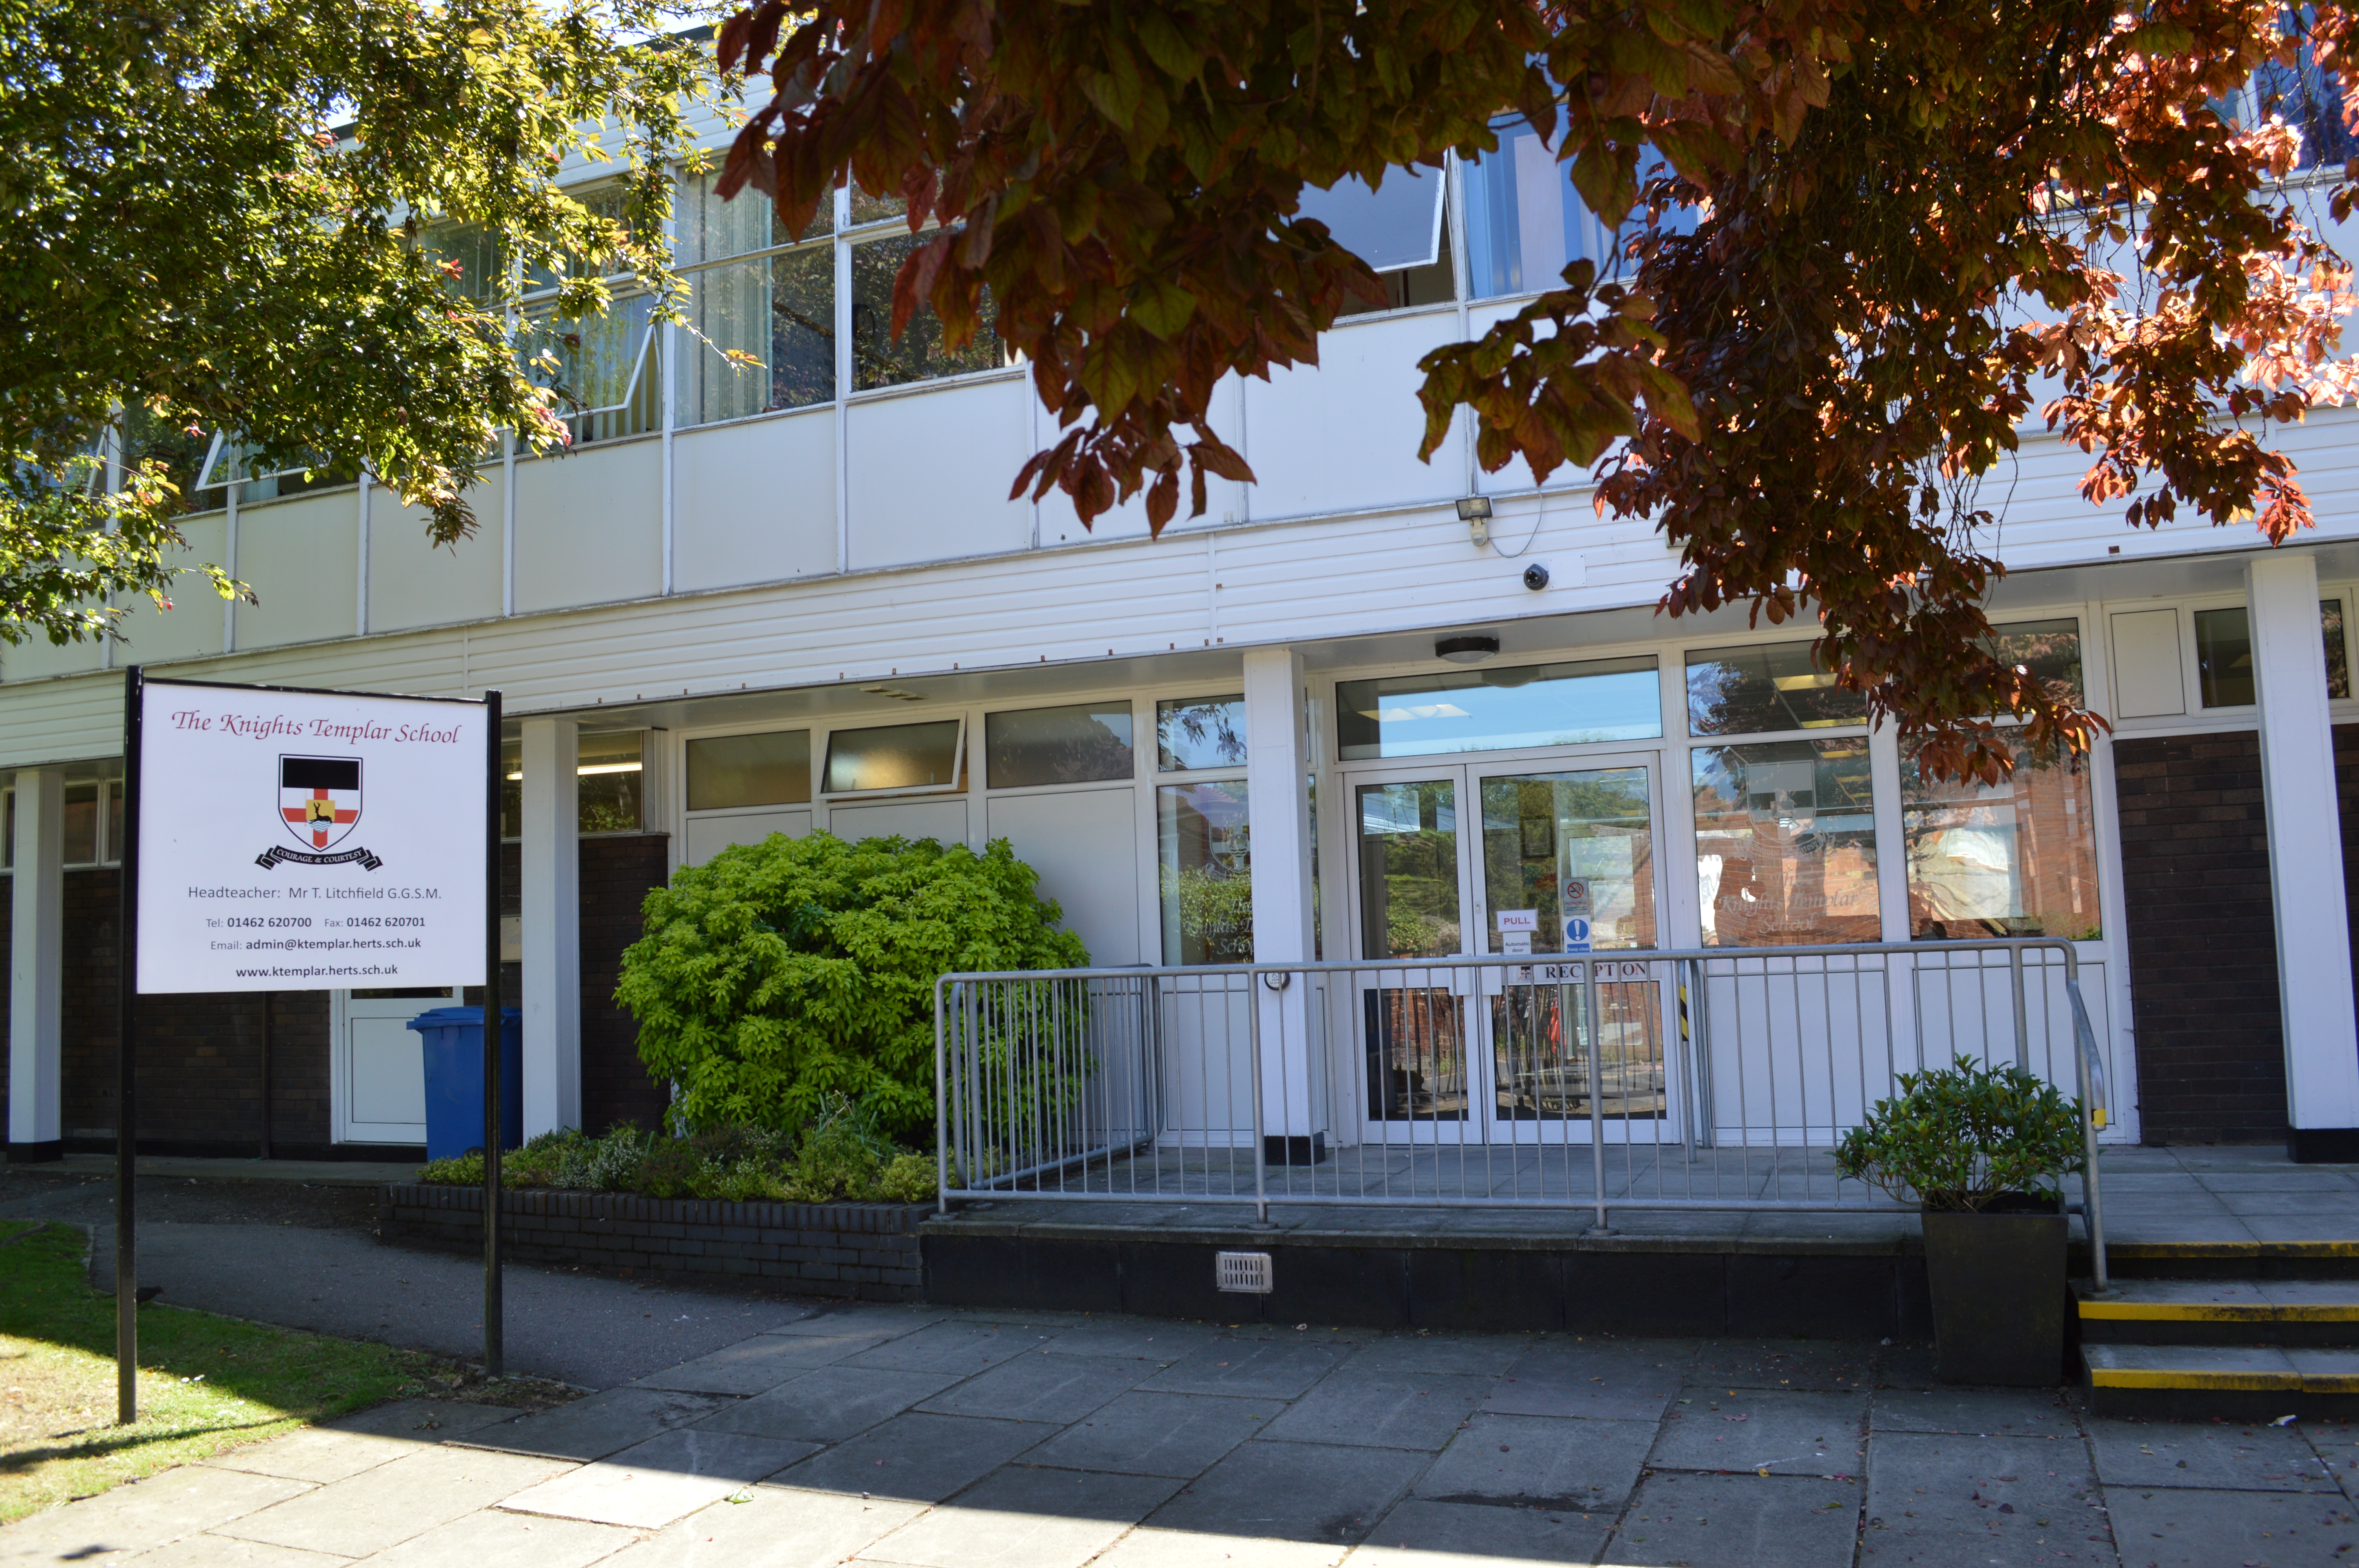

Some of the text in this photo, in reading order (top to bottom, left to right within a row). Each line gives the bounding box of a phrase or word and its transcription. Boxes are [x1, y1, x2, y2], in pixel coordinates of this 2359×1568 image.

[172, 710, 462, 744] The Knights Templar School
[276, 849, 313, 862] COURAGE
[324, 850, 362, 863] COURTESY
[1769, 869, 1805, 887] The
[189, 886, 441, 898] Headteacher: Mr T. Litchfield G.G.S.M.
[1719, 889, 1859, 916] Knights Templar
[206, 919, 223, 927] Tel:
[227, 918, 264, 927] 01462
[268, 918, 312, 927] 620700
[347, 918, 381, 927] 01462
[385, 917, 425, 926] 620701
[1759, 912, 1817, 933] School
[211, 938, 421, 951] Email: admin@ktemplar.herts.sch.uk
[236, 964, 398, 978] www.ktemplar.herts.sch.uk
[1545, 963, 1646, 978] RECPTON
